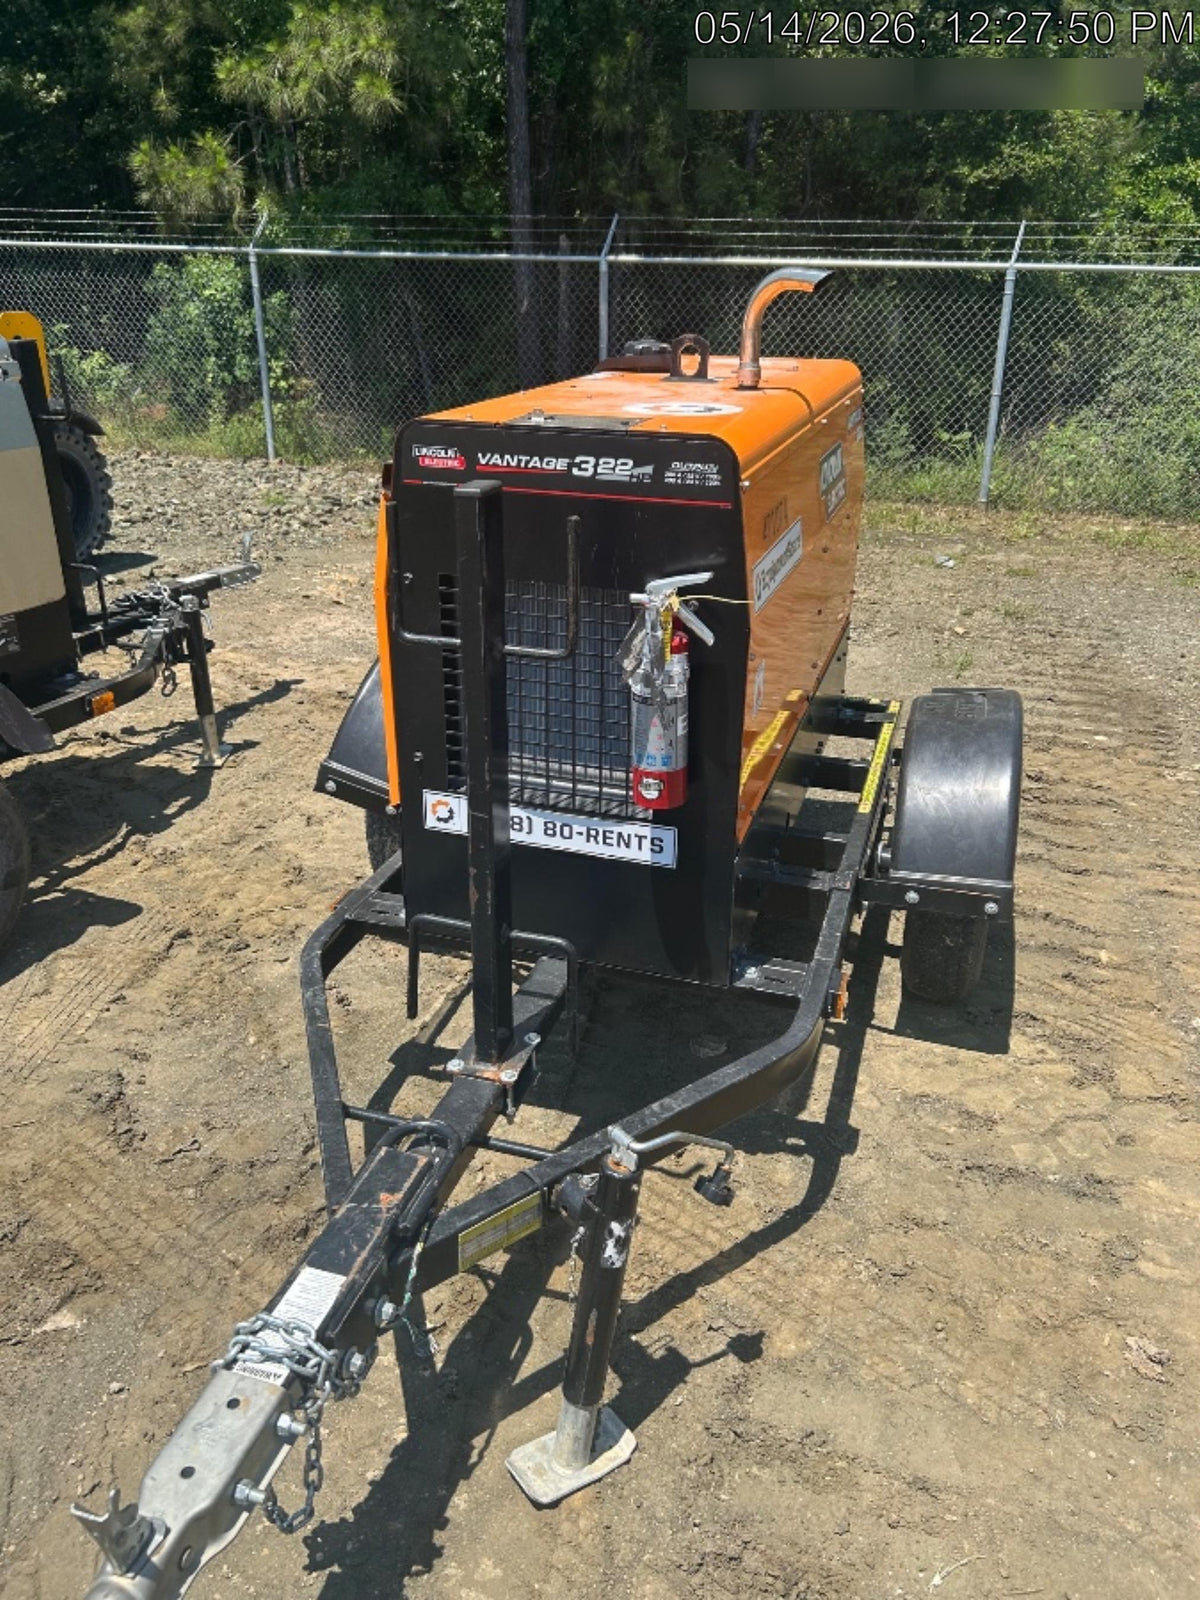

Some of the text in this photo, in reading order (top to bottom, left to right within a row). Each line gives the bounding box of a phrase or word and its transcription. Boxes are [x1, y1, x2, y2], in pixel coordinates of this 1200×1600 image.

[414, 446, 458, 459] LINCOLN
[477, 452, 569, 471] VANTAGE
[572, 455, 634, 478] 322
[542, 819, 665, 855] 80-RENTS
